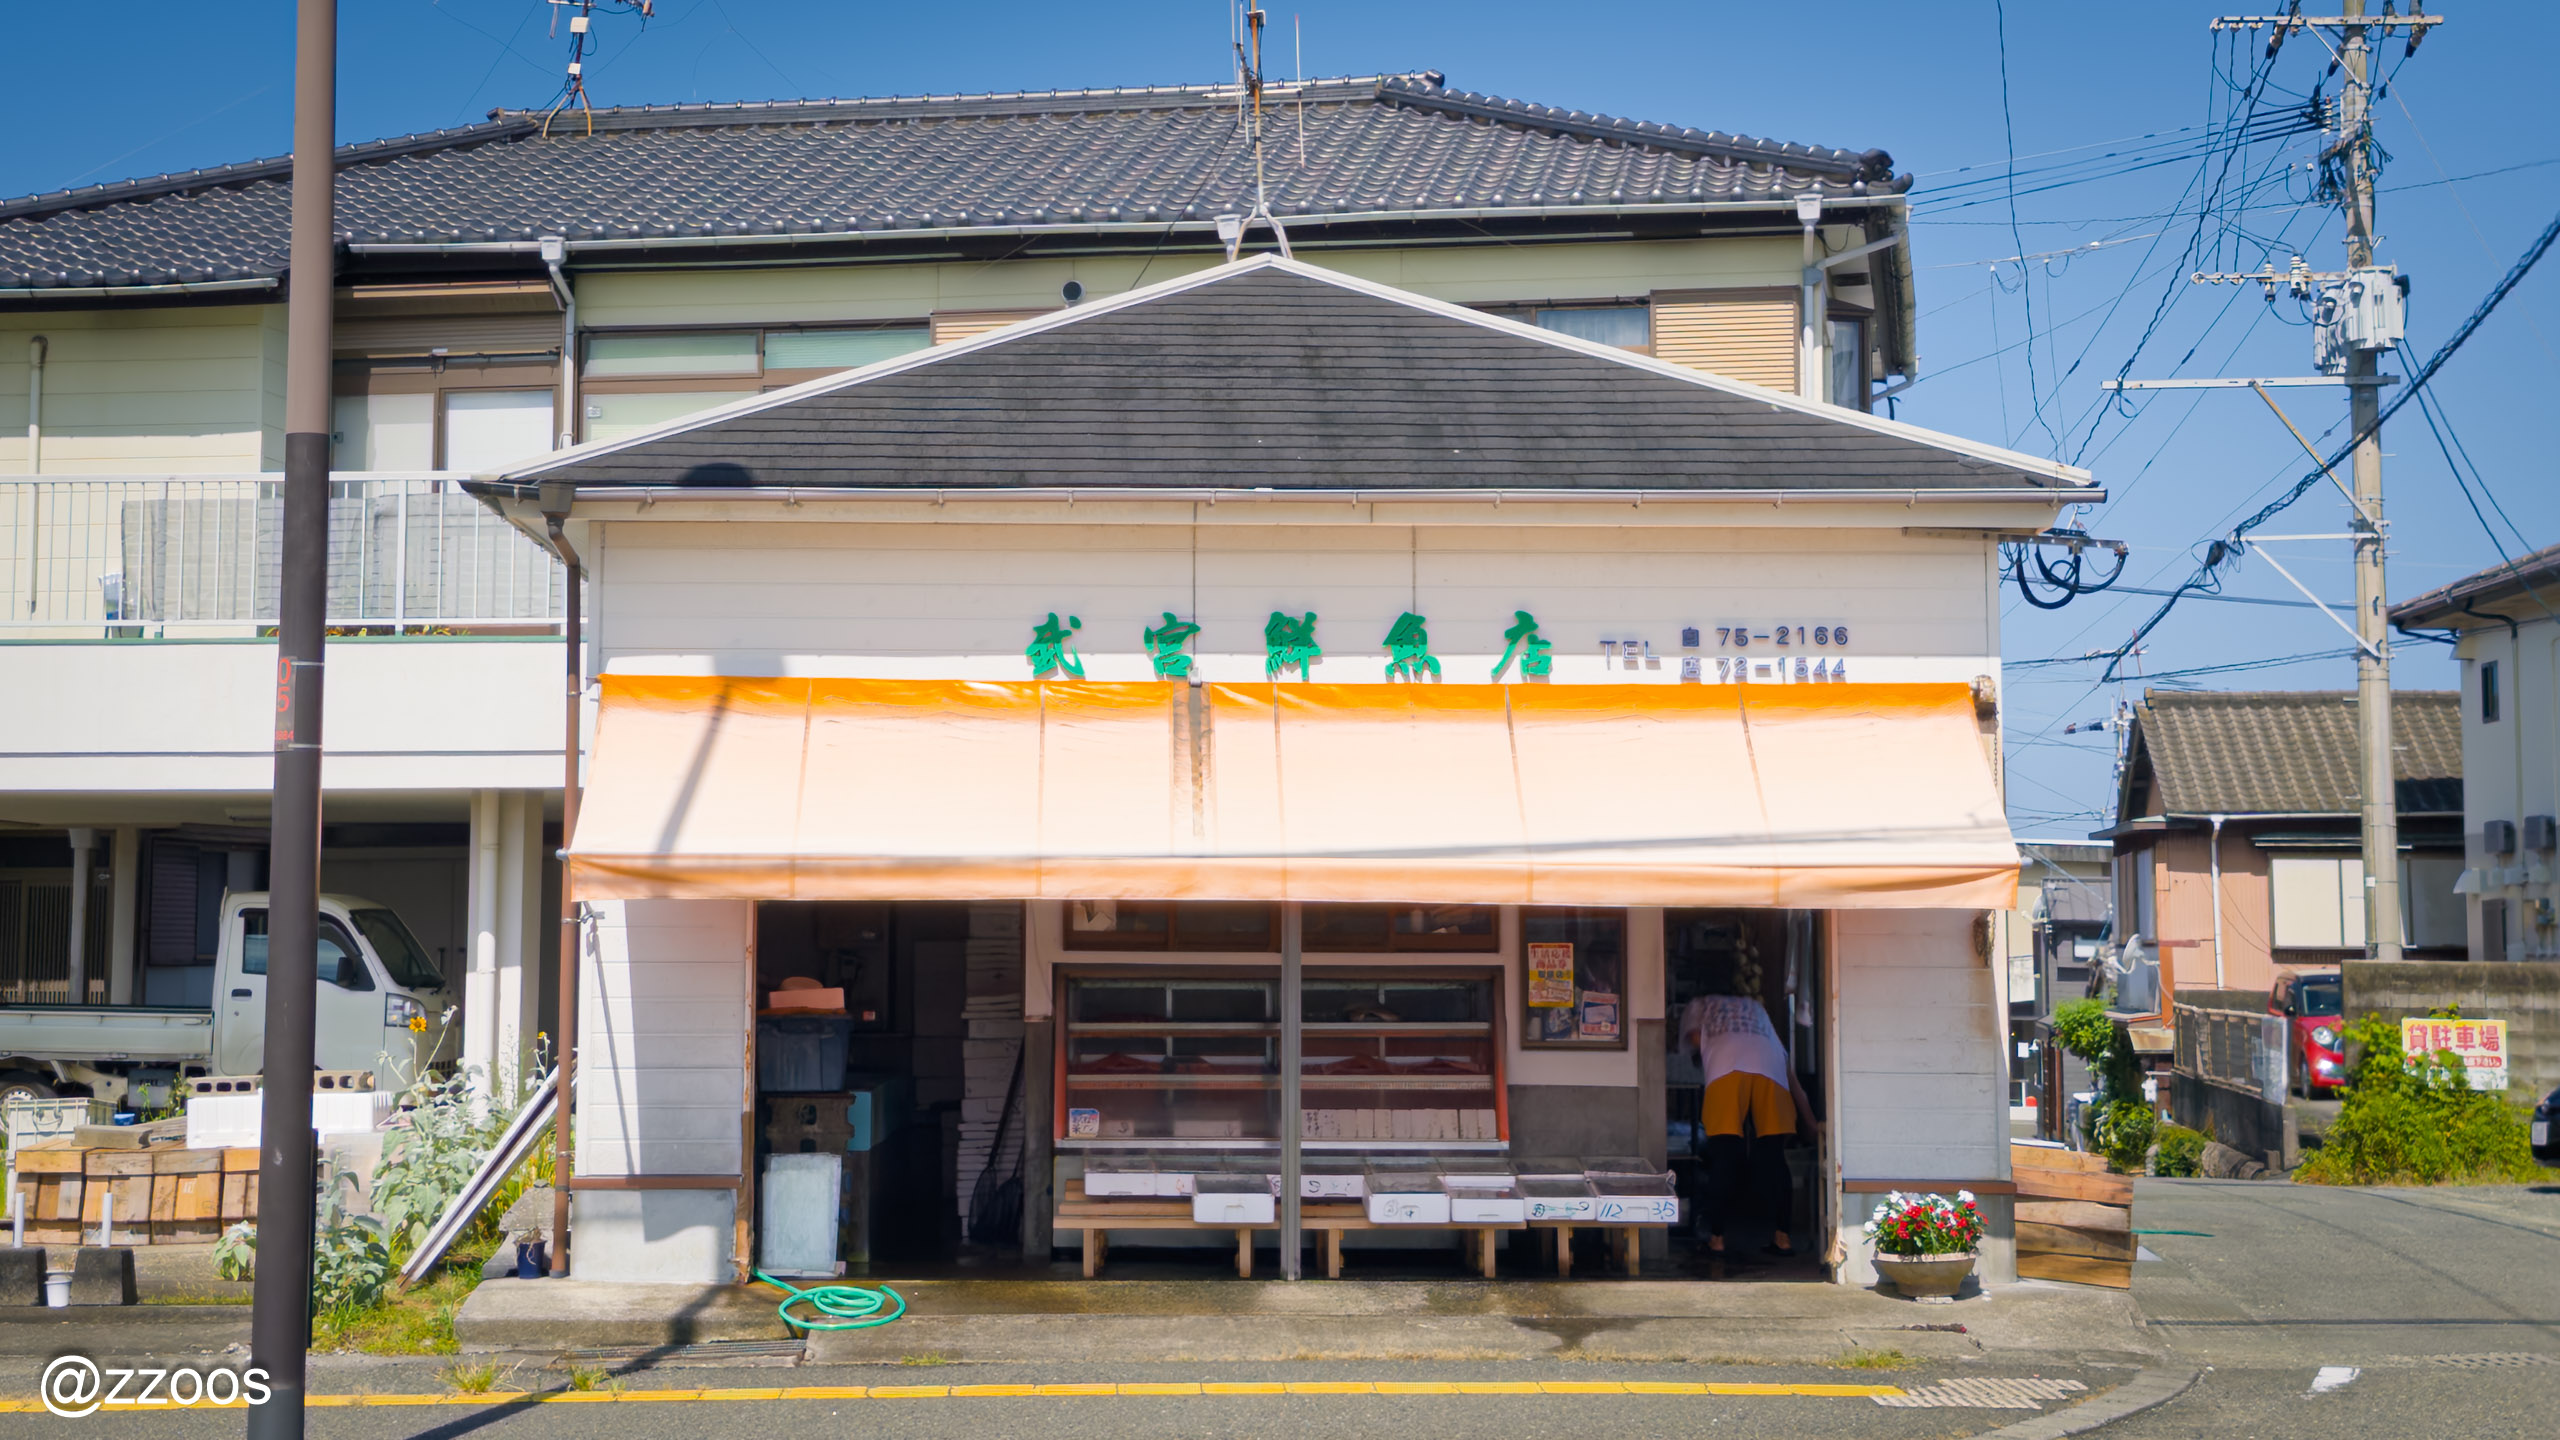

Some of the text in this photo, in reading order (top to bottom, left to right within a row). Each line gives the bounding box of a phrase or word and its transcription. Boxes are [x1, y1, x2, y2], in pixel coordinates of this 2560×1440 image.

[1716, 626, 1848, 646] 75-2166
[1600, 641, 1660, 660] TEL
[1716, 657, 1846, 677] 72-1544
[2408, 1024, 2500, 1052] 貸駐車場
